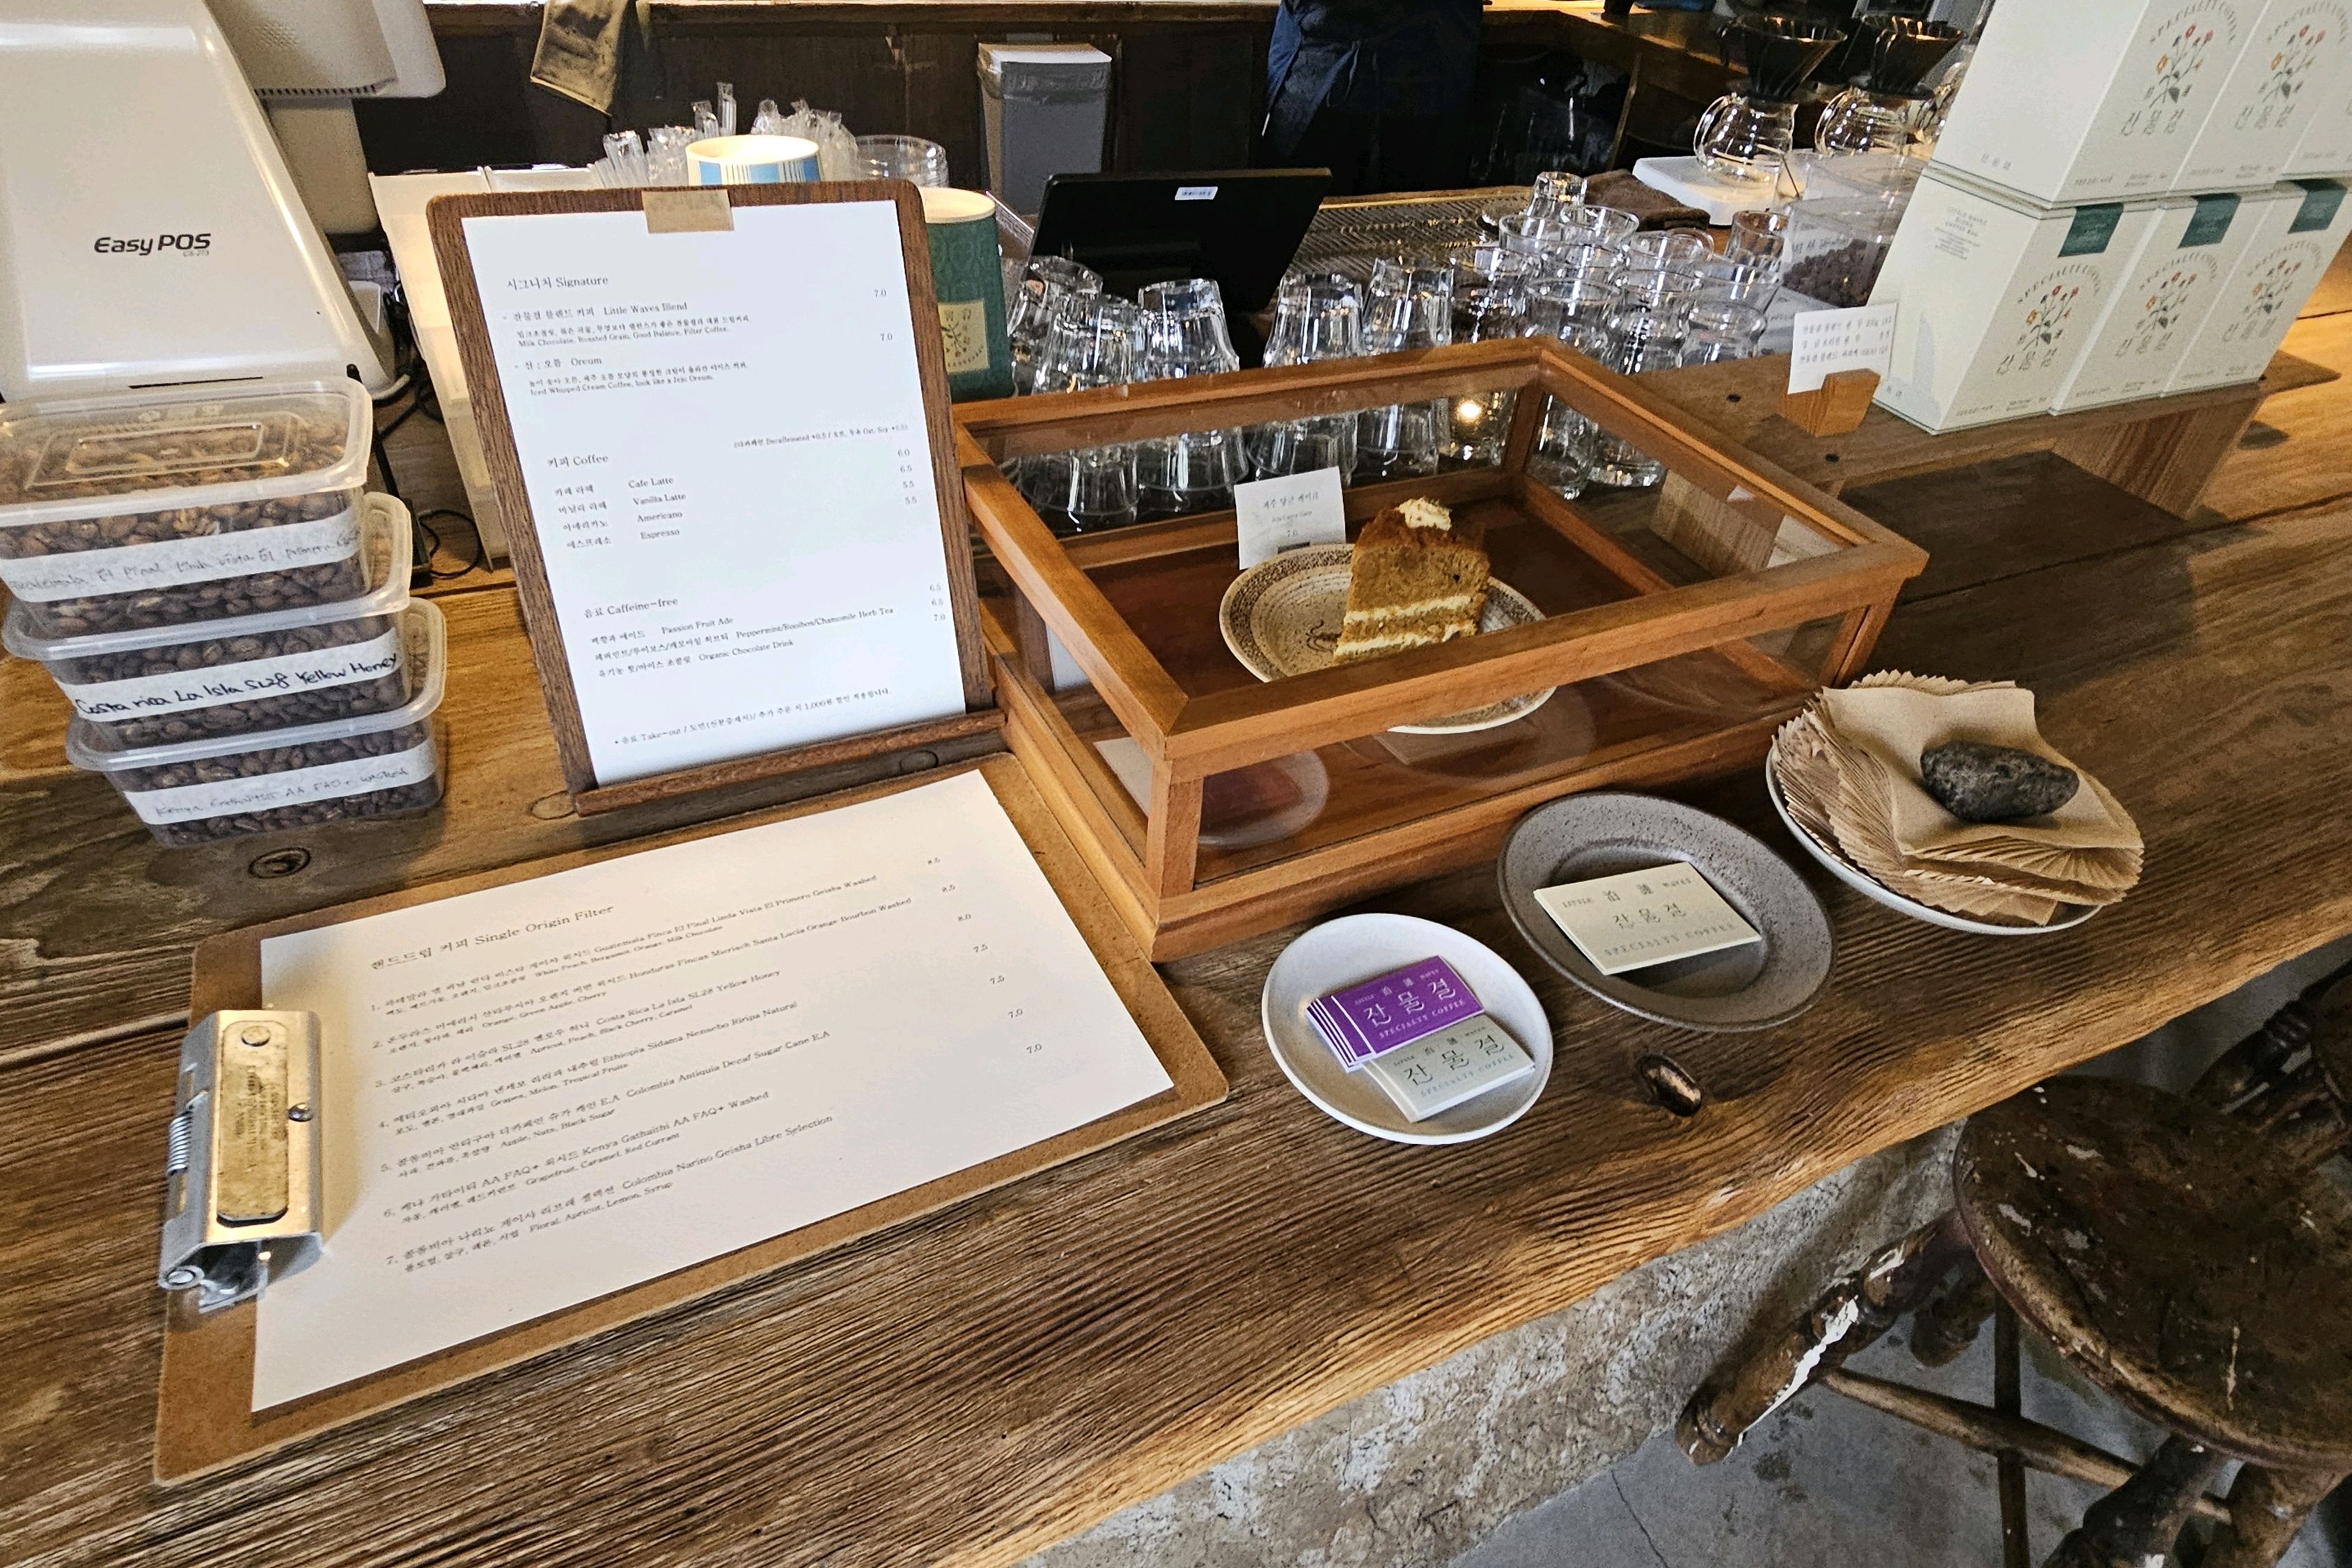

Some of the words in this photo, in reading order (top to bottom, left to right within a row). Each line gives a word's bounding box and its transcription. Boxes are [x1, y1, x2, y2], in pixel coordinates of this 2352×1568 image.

[93, 236, 153, 256] Easy
[157, 233, 212, 251] POS
[506, 276, 553, 292] 시그니처
[554, 276, 609, 289] Signature
[872, 288, 888, 299] 7.0
[602, 305, 629, 316] Little
[629, 304, 661, 314] Waves
[660, 301, 689, 313] Blend
[879, 331, 894, 343] 7.0
[570, 356, 603, 368] Oreum
[547, 455, 571, 469] 커피
[572, 453, 610, 467] Coffee
[897, 448, 911, 458] 6.0
[627, 478, 650, 489] Cafe
[649, 476, 675, 487] Latte
[632, 494, 664, 506] Vanilla
[663, 493, 687, 503] Latte
[562, 519, 609, 533] 아메리카노
[636, 511, 684, 524] Americano
[565, 535, 613, 550] 에스프레소
[639, 528, 681, 541] Espresso
[606, 597, 679, 616] Caffeine-free
[660, 622, 695, 636] Passion
[694, 619, 716, 630] Fruit
[717, 616, 735, 627] Ade
[932, 613, 947, 622] 7.0
[697, 650, 730, 662] Organic
[730, 643, 771, 657] Chocolate
[771, 638, 795, 650] Drink
[75, 697, 130, 714] Costa
[176, 689, 203, 702] La
[296, 665, 347, 685] Yellow
[351, 652, 398, 675] Honey
[370, 946, 433, 971] 핸드드립
[439, 937, 469, 953] 커피
[473, 927, 521, 946] Single
[524, 916, 572, 934] Origin
[573, 905, 615, 922] Filter
[972, 942, 989, 954] 7.5
[988, 974, 1006, 986] 7.5
[595, 1013, 627, 1026] Costa
[627, 1006, 651, 1017] Rica
[650, 1001, 666, 1011] La
[666, 996, 687, 1007] Isla
[715, 978, 749, 992] Yellow
[749, 969, 781, 984] Honey
[1363, 976, 1457, 1028] 잔물결
[1007, 1008, 1024, 1020] 7.0
[1378, 1013, 1429, 1040] SPECIALTY
[1431, 999, 1466, 1017] COFFEE
[601, 1046, 646, 1065] Ethiopia
[646, 1035, 685, 1051] Sidama
[684, 1021, 730, 1040] Nensebo
[761, 1000, 799, 1018] Natural
[371, 1040, 384, 1050] 2.
[1025, 1042, 1043, 1056] 7.0
[625, 1078, 676, 1099] Colombia
[721, 1053, 752, 1069] Decaf
[753, 1044, 784, 1060] Sugar
[784, 1037, 810, 1050] Cane
[1403, 1033, 1505, 1086] 잔물결
[480, 1175, 502, 1189] AA
[503, 1163, 540, 1182] FAQ+
[581, 1140, 620, 1157] Kenya
[672, 1115, 691, 1129] AA
[691, 1105, 726, 1122] FAQ+
[727, 1090, 770, 1109] Washed
[385, 1254, 399, 1266] 7.
[621, 1168, 675, 1191] Colombia
[675, 1155, 714, 1173] Narino
[714, 1142, 753, 1159] Geisha
[753, 1132, 783, 1147] Libre
[783, 1115, 834, 1138] Selection
